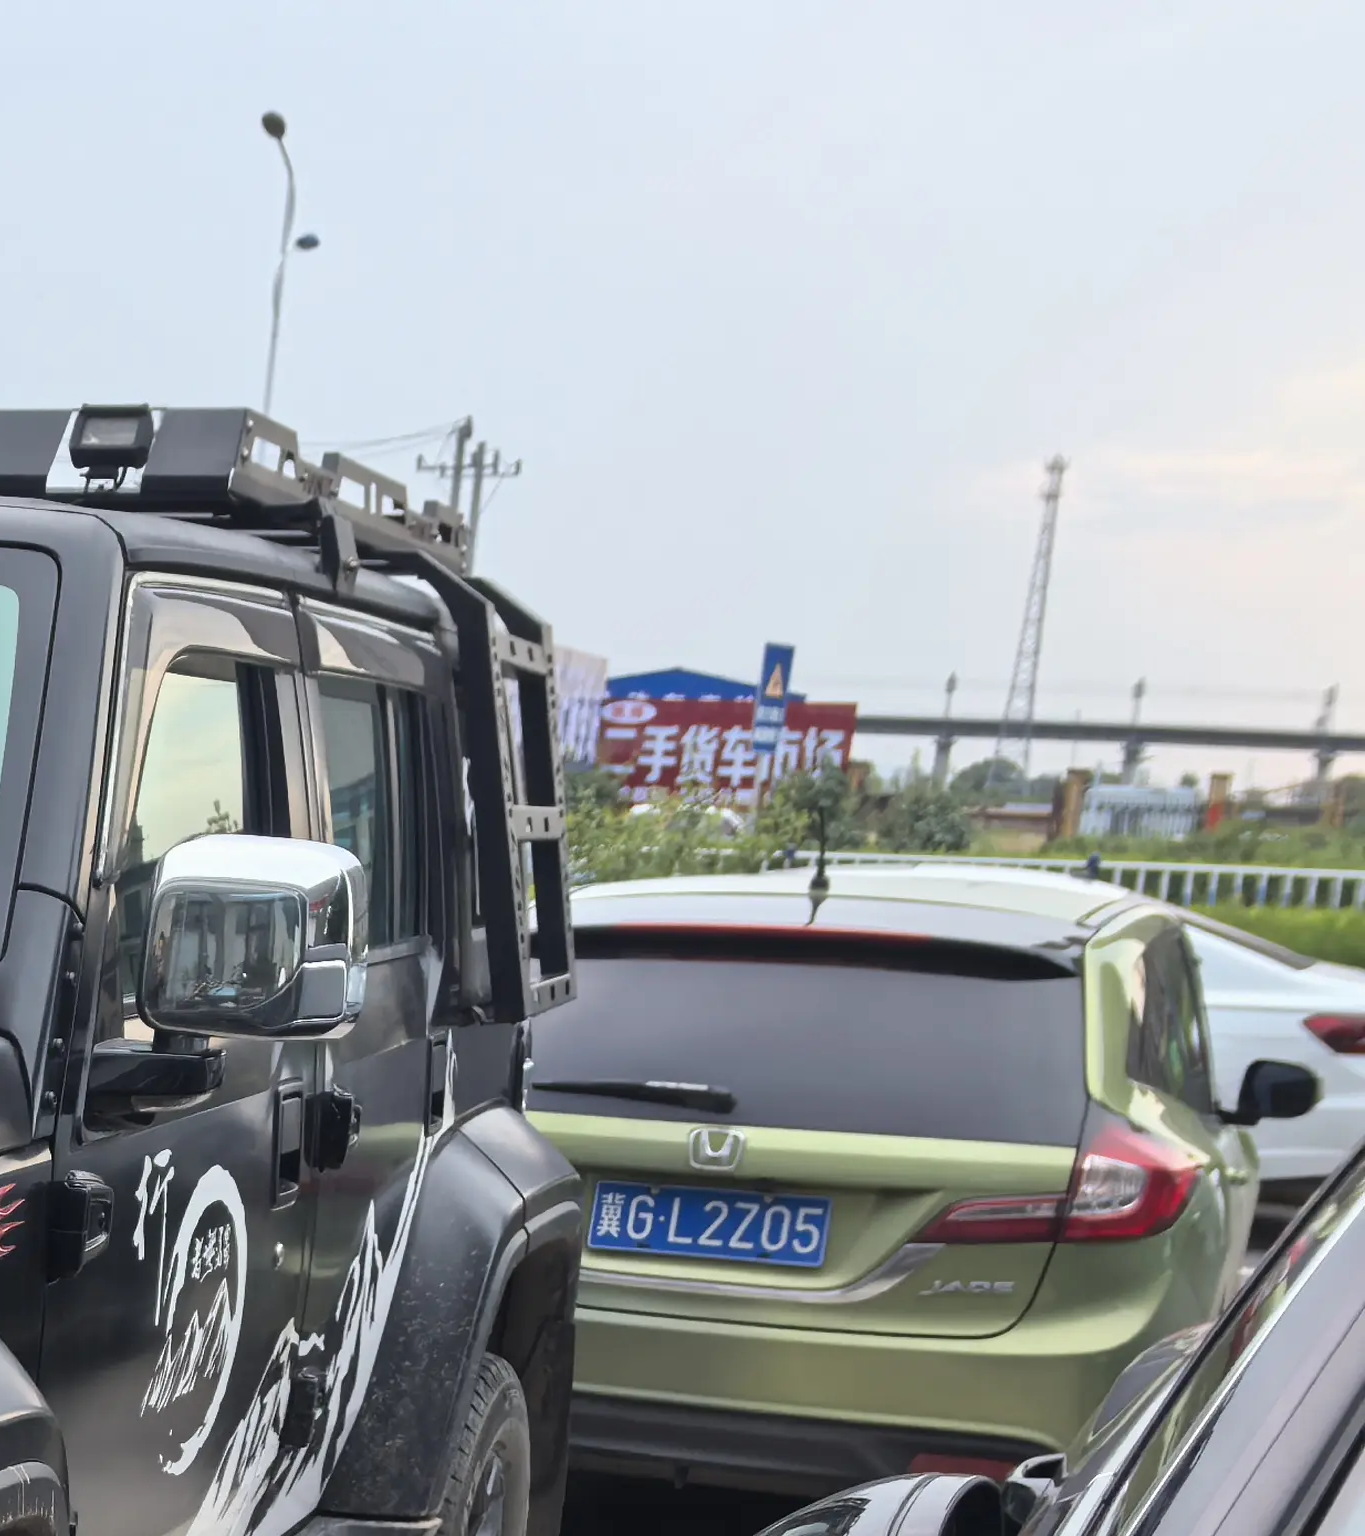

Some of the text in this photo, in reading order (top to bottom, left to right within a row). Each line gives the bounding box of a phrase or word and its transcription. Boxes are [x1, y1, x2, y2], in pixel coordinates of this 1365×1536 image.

[601, 723, 847, 788] 二手货车市场
[596, 1191, 824, 1255] 冀G·L2Z05
[917, 1279, 1015, 1296] JADE
